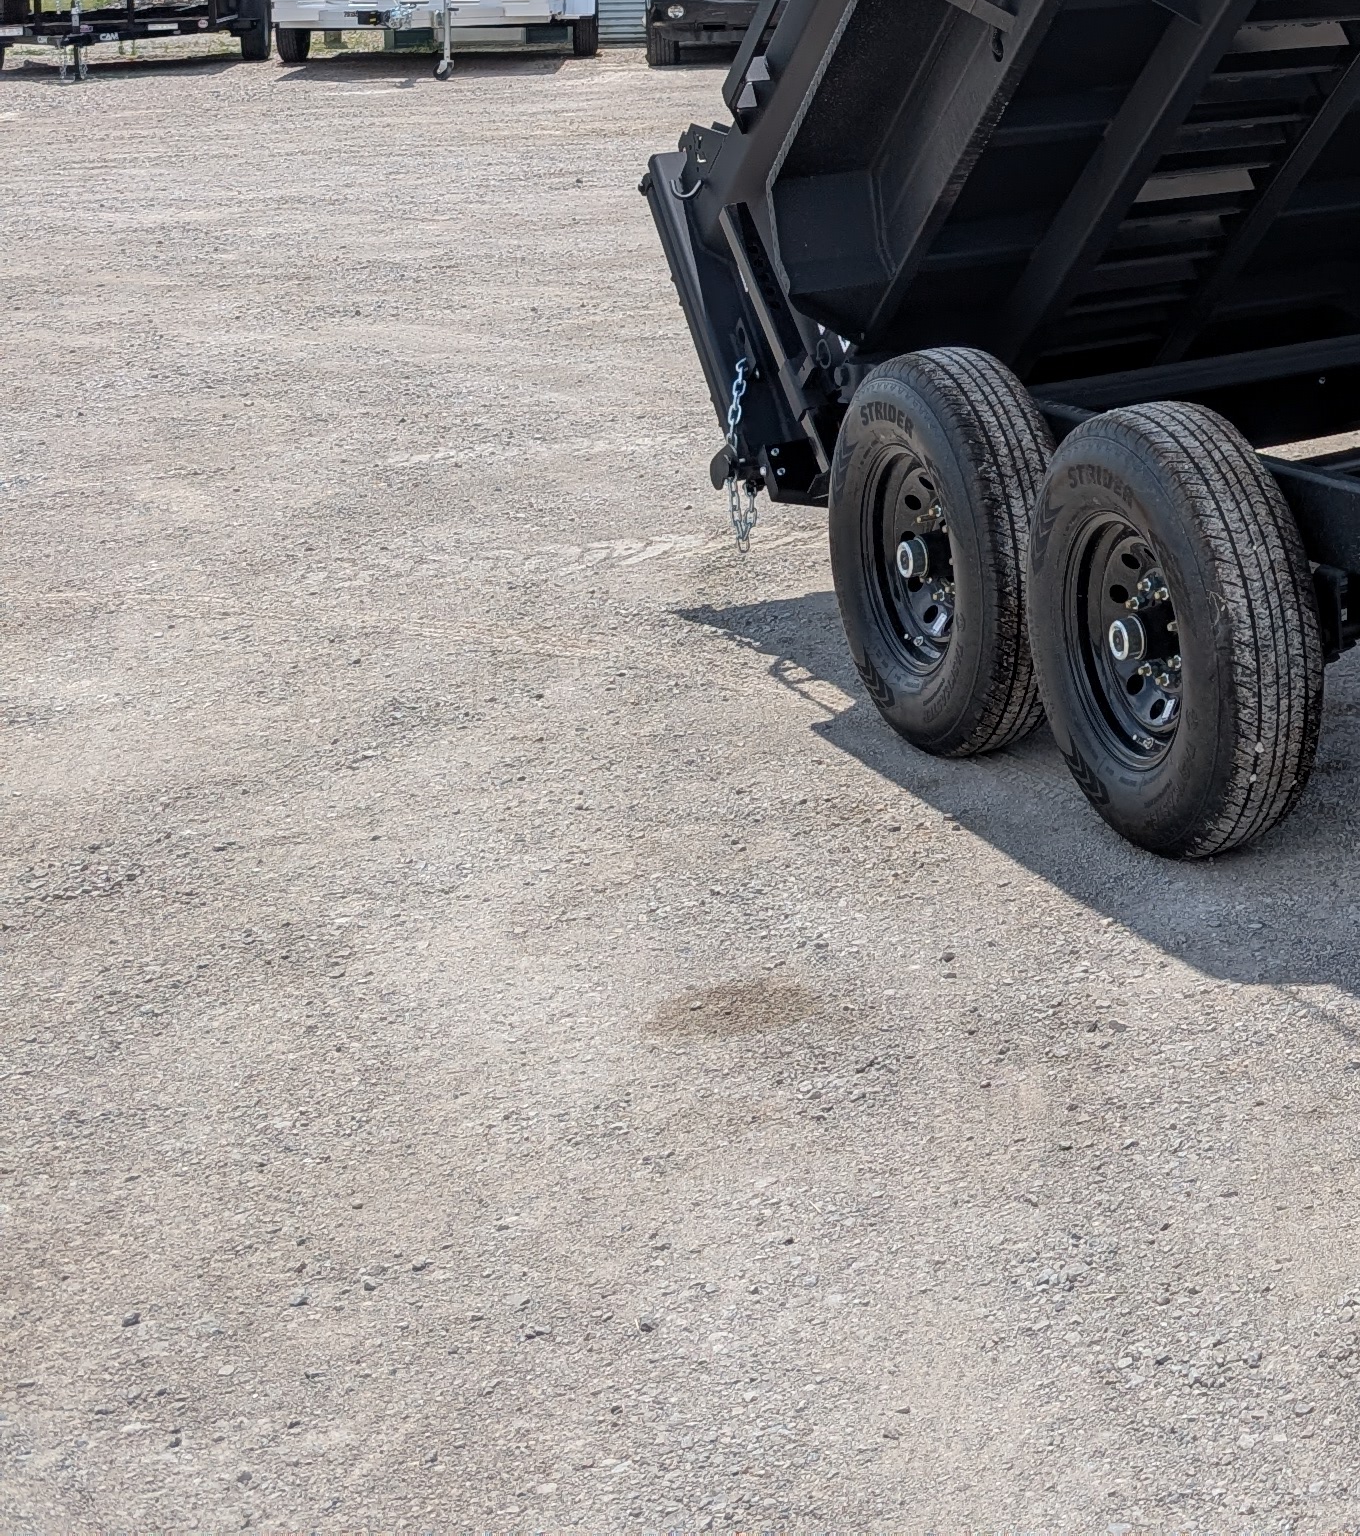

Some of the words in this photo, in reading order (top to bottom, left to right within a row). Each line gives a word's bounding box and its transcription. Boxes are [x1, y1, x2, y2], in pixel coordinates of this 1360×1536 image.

[99, 32, 119, 40] CAM
[860, 401, 914, 439] STRIDER
[1067, 463, 1135, 508] STRIDER
